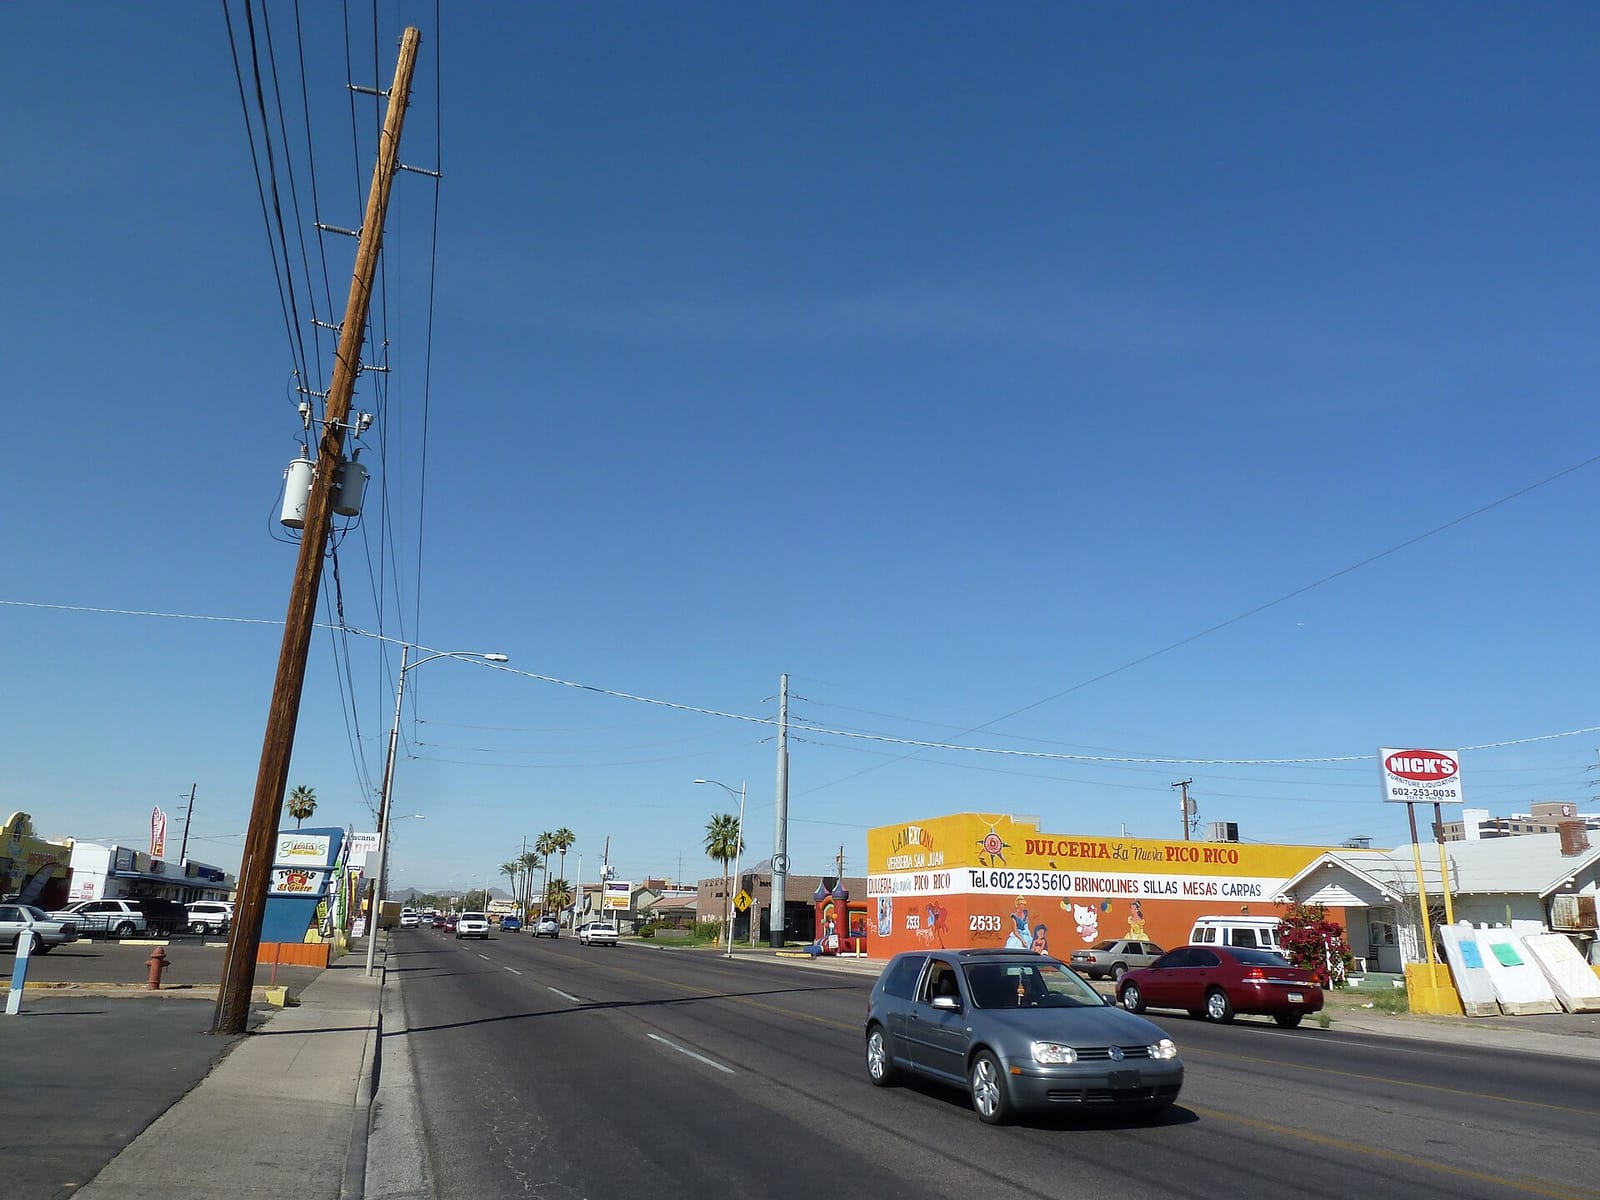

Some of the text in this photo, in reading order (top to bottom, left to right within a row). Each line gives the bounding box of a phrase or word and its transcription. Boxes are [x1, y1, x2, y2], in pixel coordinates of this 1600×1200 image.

[1390, 757, 1454, 774] NICK'S
[1387, 772, 1458, 788] FURNITURE LIQUIDATION
[1392, 788, 1456, 797] 602-253-0035
[913, 853, 924, 868] SAN
[928, 850, 944, 867] JUAN
[1025, 839, 1111, 859] DULCERIA
[1111, 843, 1129, 860] La
[1165, 846, 1200, 862] PICO
[1203, 848, 1239, 864] RICO
[278, 869, 317, 880] TORTAS
[868, 878, 891, 894] DULCERIA
[914, 874, 929, 891] PICO
[933, 873, 951, 889] RICO
[969, 870, 1262, 897] Tel. 602 253 5610 BRINCOLINES SILLAS MESAS CARPAS
